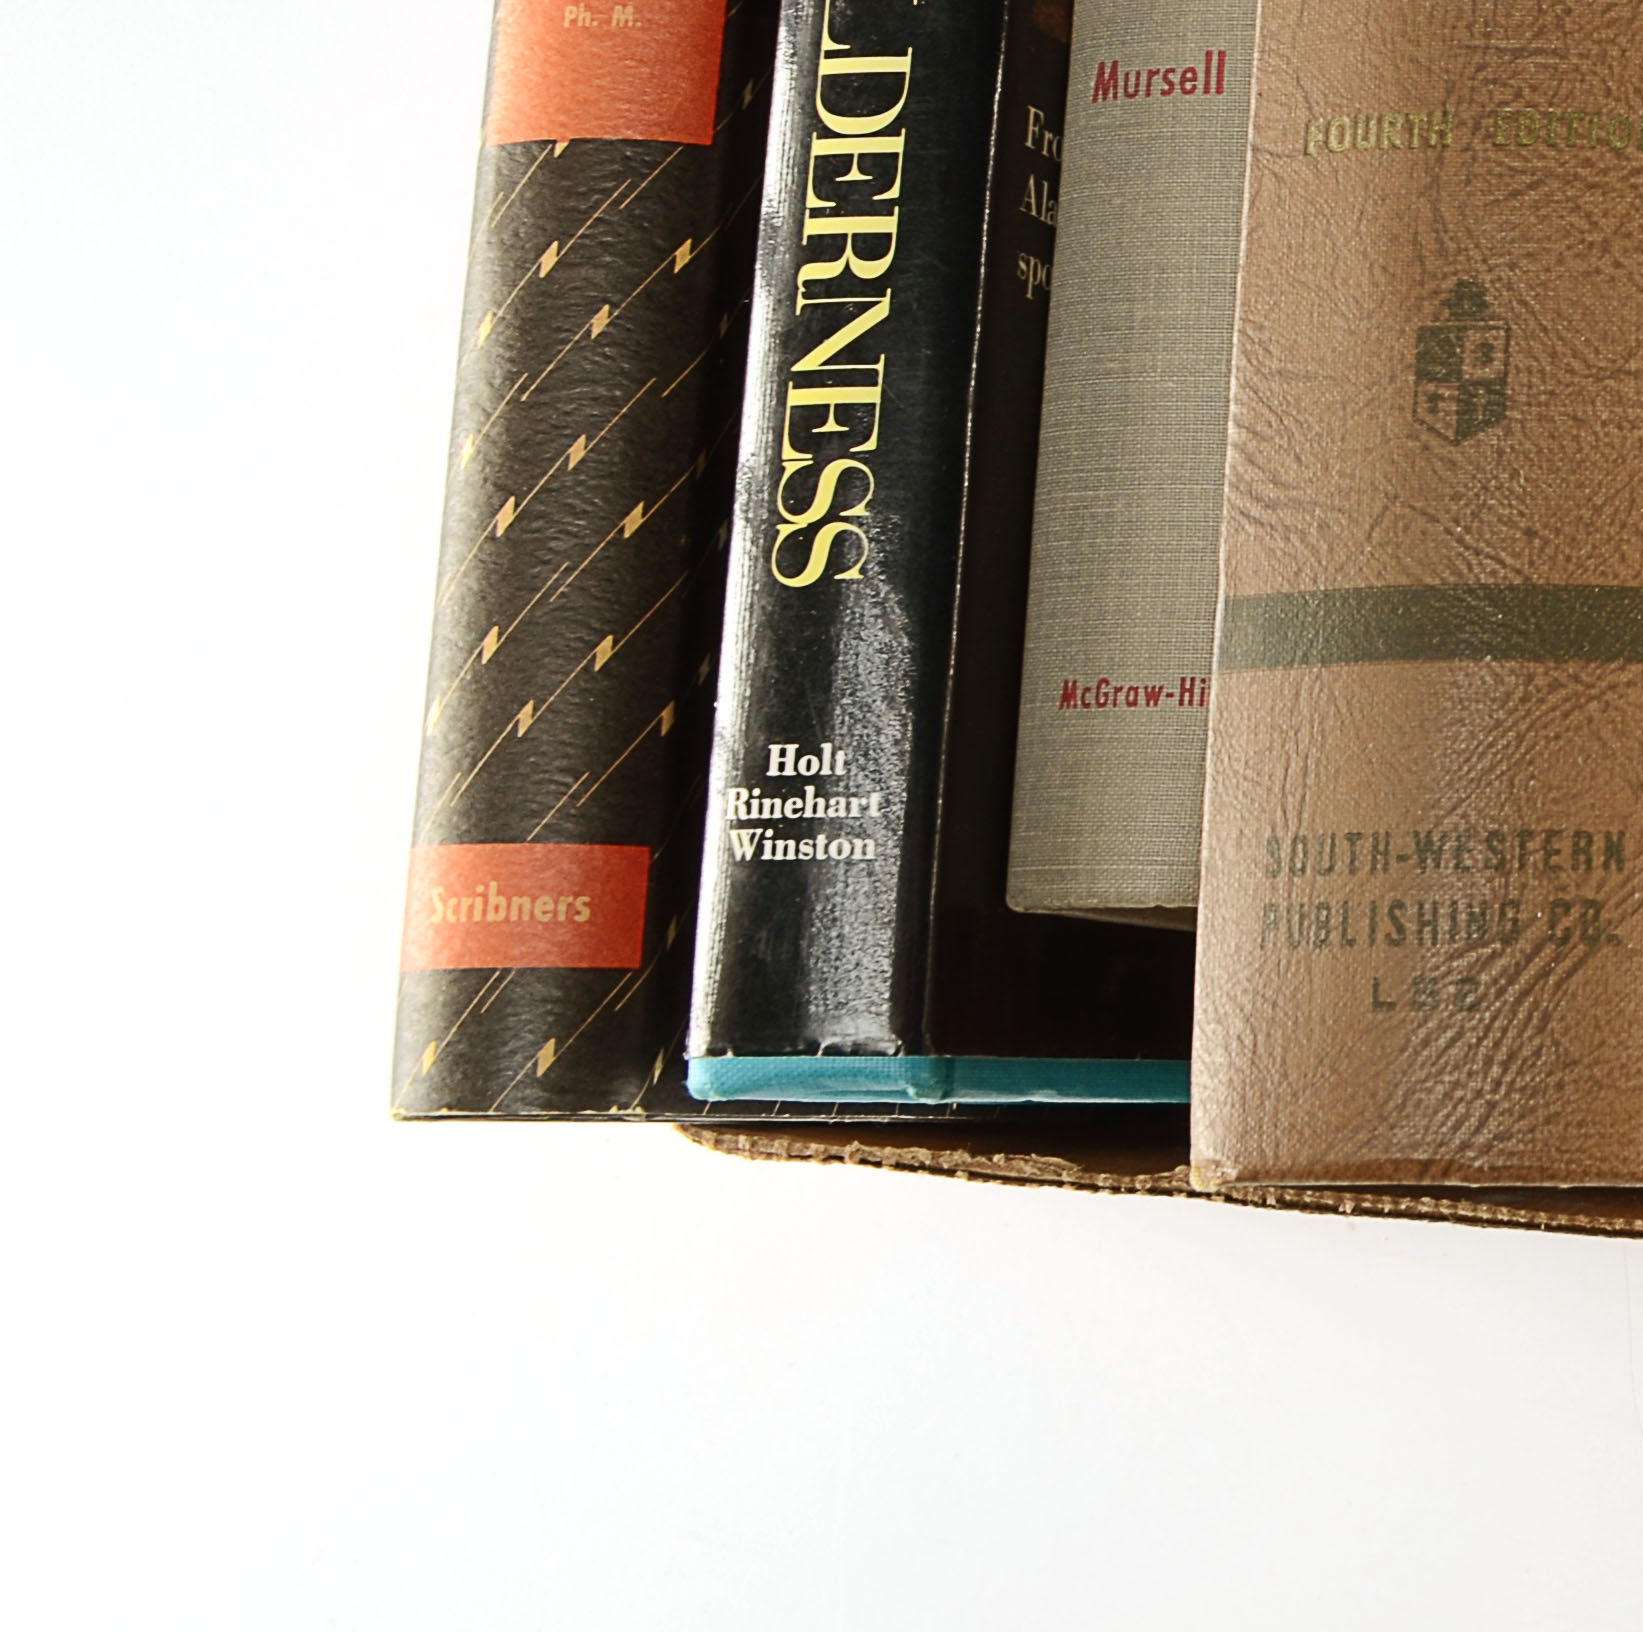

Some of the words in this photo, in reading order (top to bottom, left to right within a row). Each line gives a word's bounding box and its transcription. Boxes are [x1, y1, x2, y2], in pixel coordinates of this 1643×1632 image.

[563, 2, 600, 29] Ph.
[611, 4, 643, 29] M.
[1091, 49, 1228, 105] Mursell
[1303, 110, 1454, 156] FOURTH
[1057, 675, 1211, 711] McGraw-Hi
[766, 742, 847, 778] Holt
[725, 785, 884, 821] Rinehart
[728, 828, 878, 862] Winston
[1265, 828, 1627, 879] SOUTH-WESTERN
[431, 881, 593, 925] Scribners
[1260, 898, 1522, 950] PUBLISHING
[1547, 897, 1622, 947] CO.
